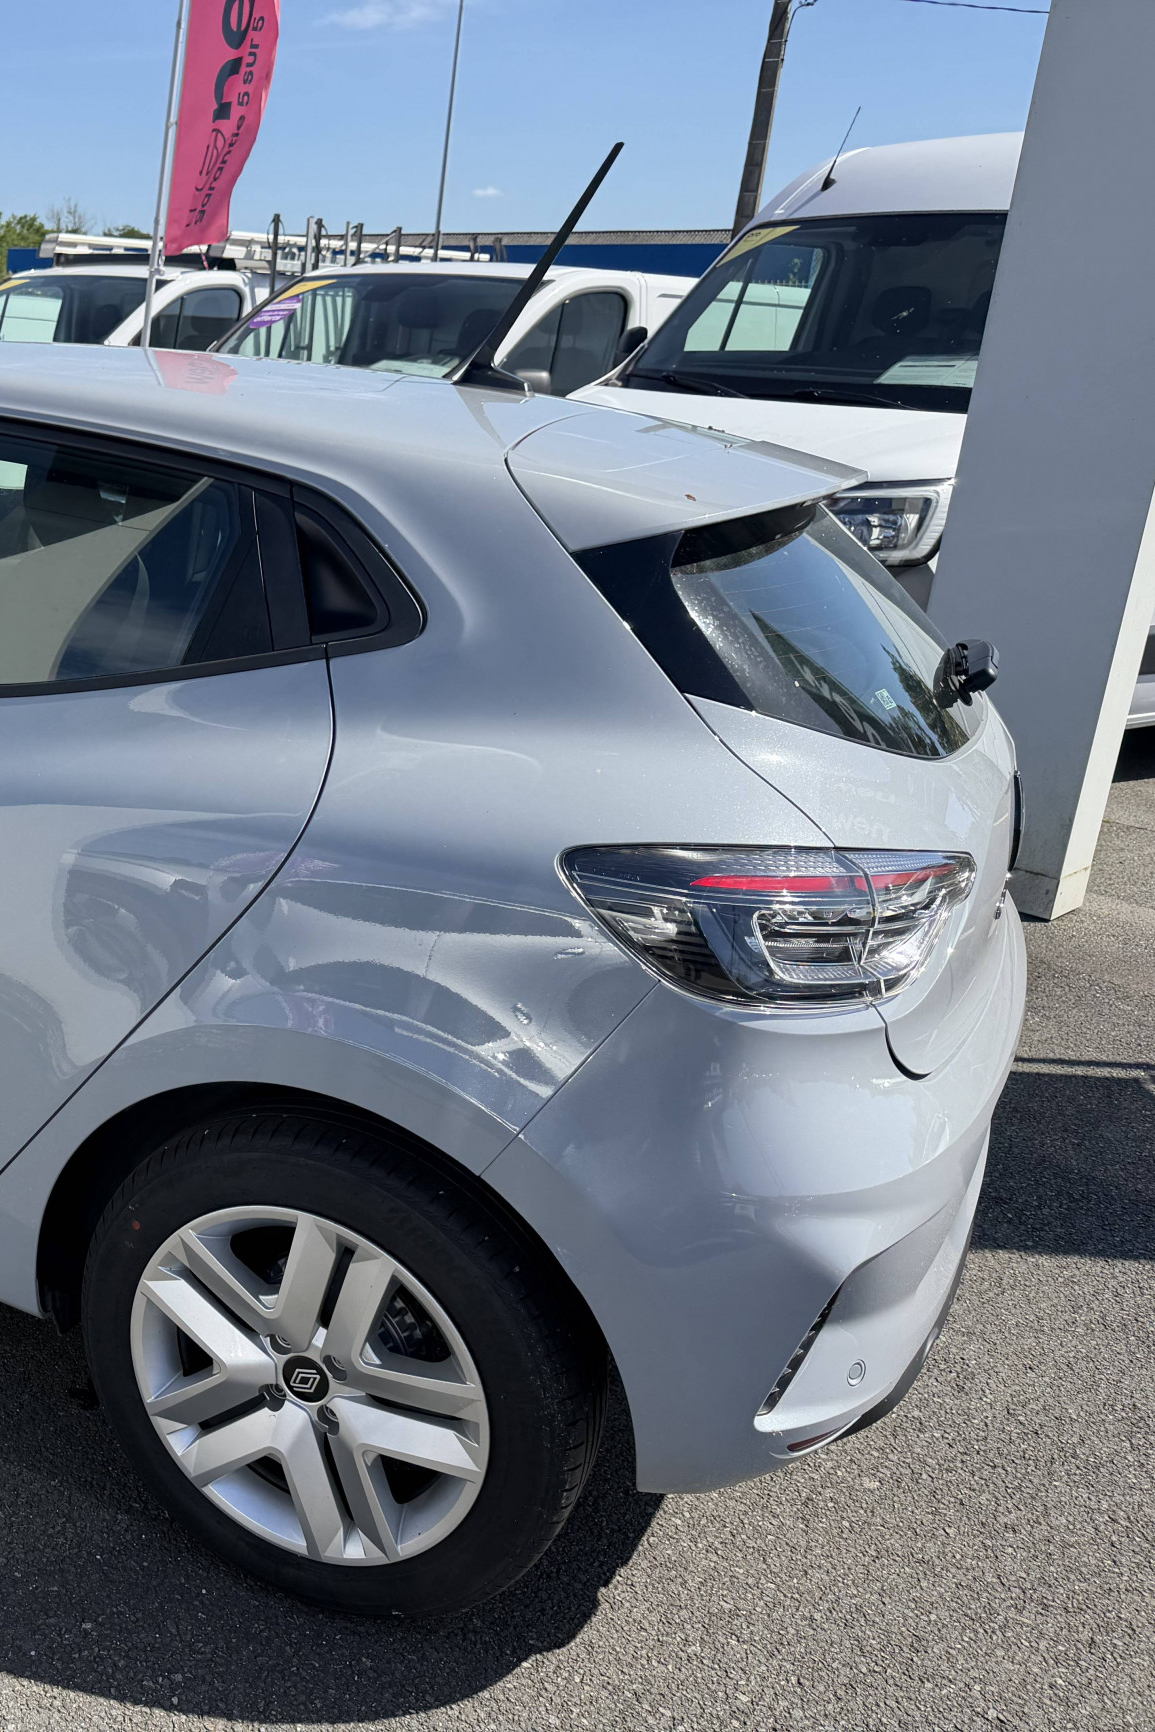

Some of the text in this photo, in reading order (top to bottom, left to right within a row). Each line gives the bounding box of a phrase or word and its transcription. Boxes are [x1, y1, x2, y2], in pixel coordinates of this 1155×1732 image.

[194, 15, 264, 225] garantie 5 sur 5
